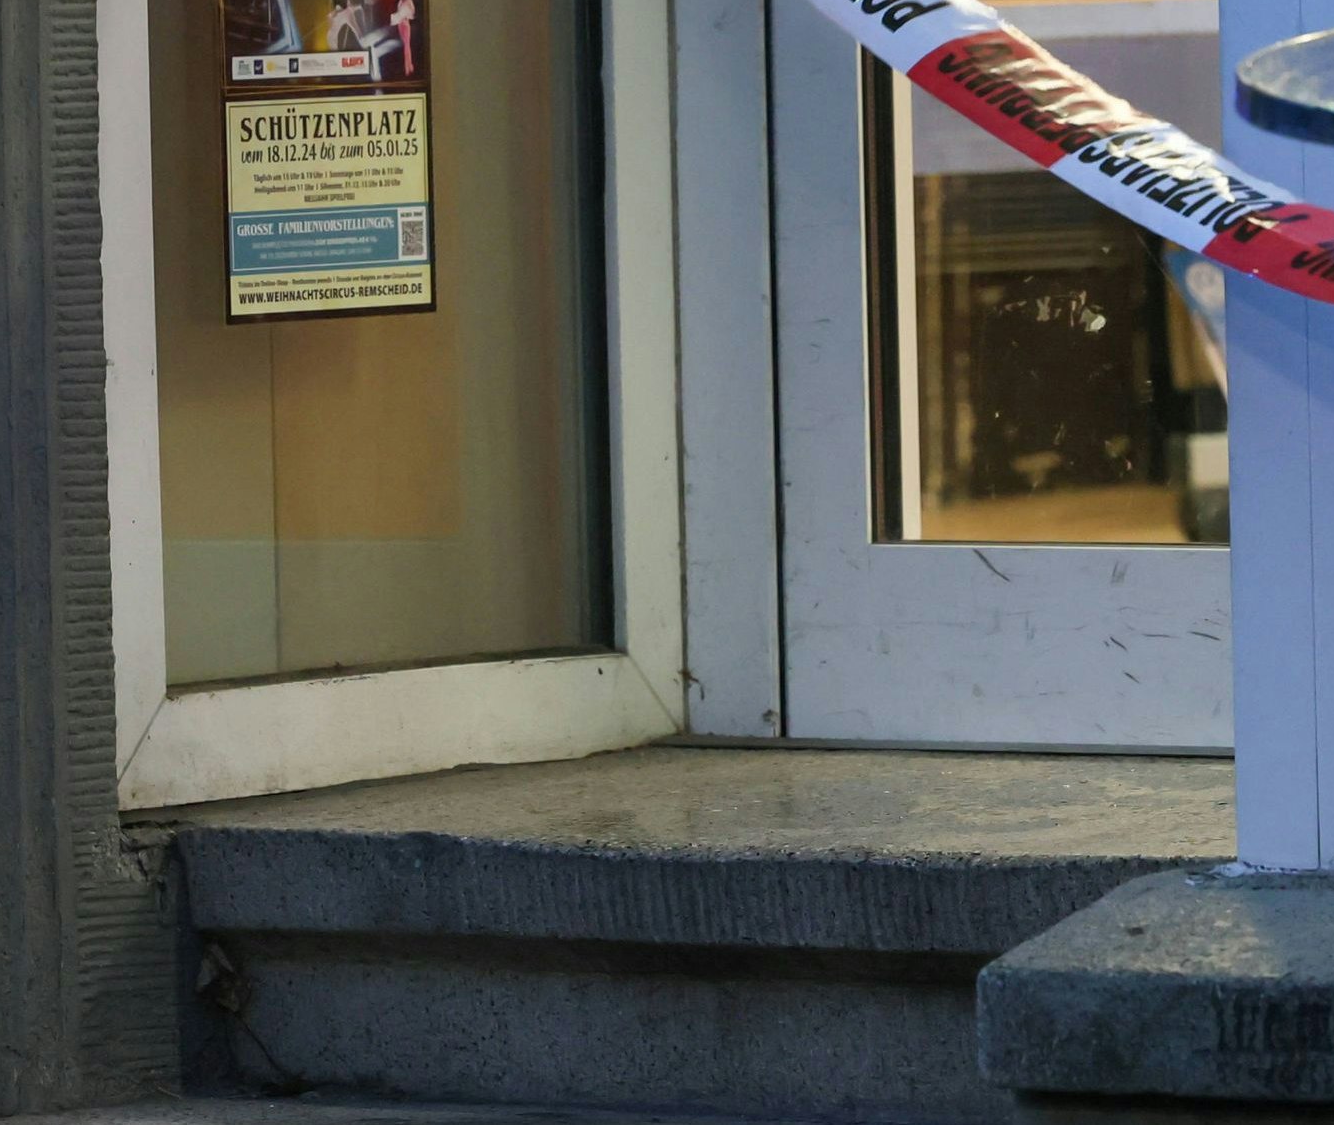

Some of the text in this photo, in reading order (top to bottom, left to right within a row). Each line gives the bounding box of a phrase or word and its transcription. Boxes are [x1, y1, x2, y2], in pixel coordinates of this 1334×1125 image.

[240, 107, 416, 142] SCHÜTZENPLATZ
[241, 138, 418, 164] vom 18.12.24 bis zum 05.01.25
[236, 222, 274, 236] GROSSE
[239, 283, 423, 305] WWW.WEIHNACHTSCIRCUS-REMSCHEID.DE
